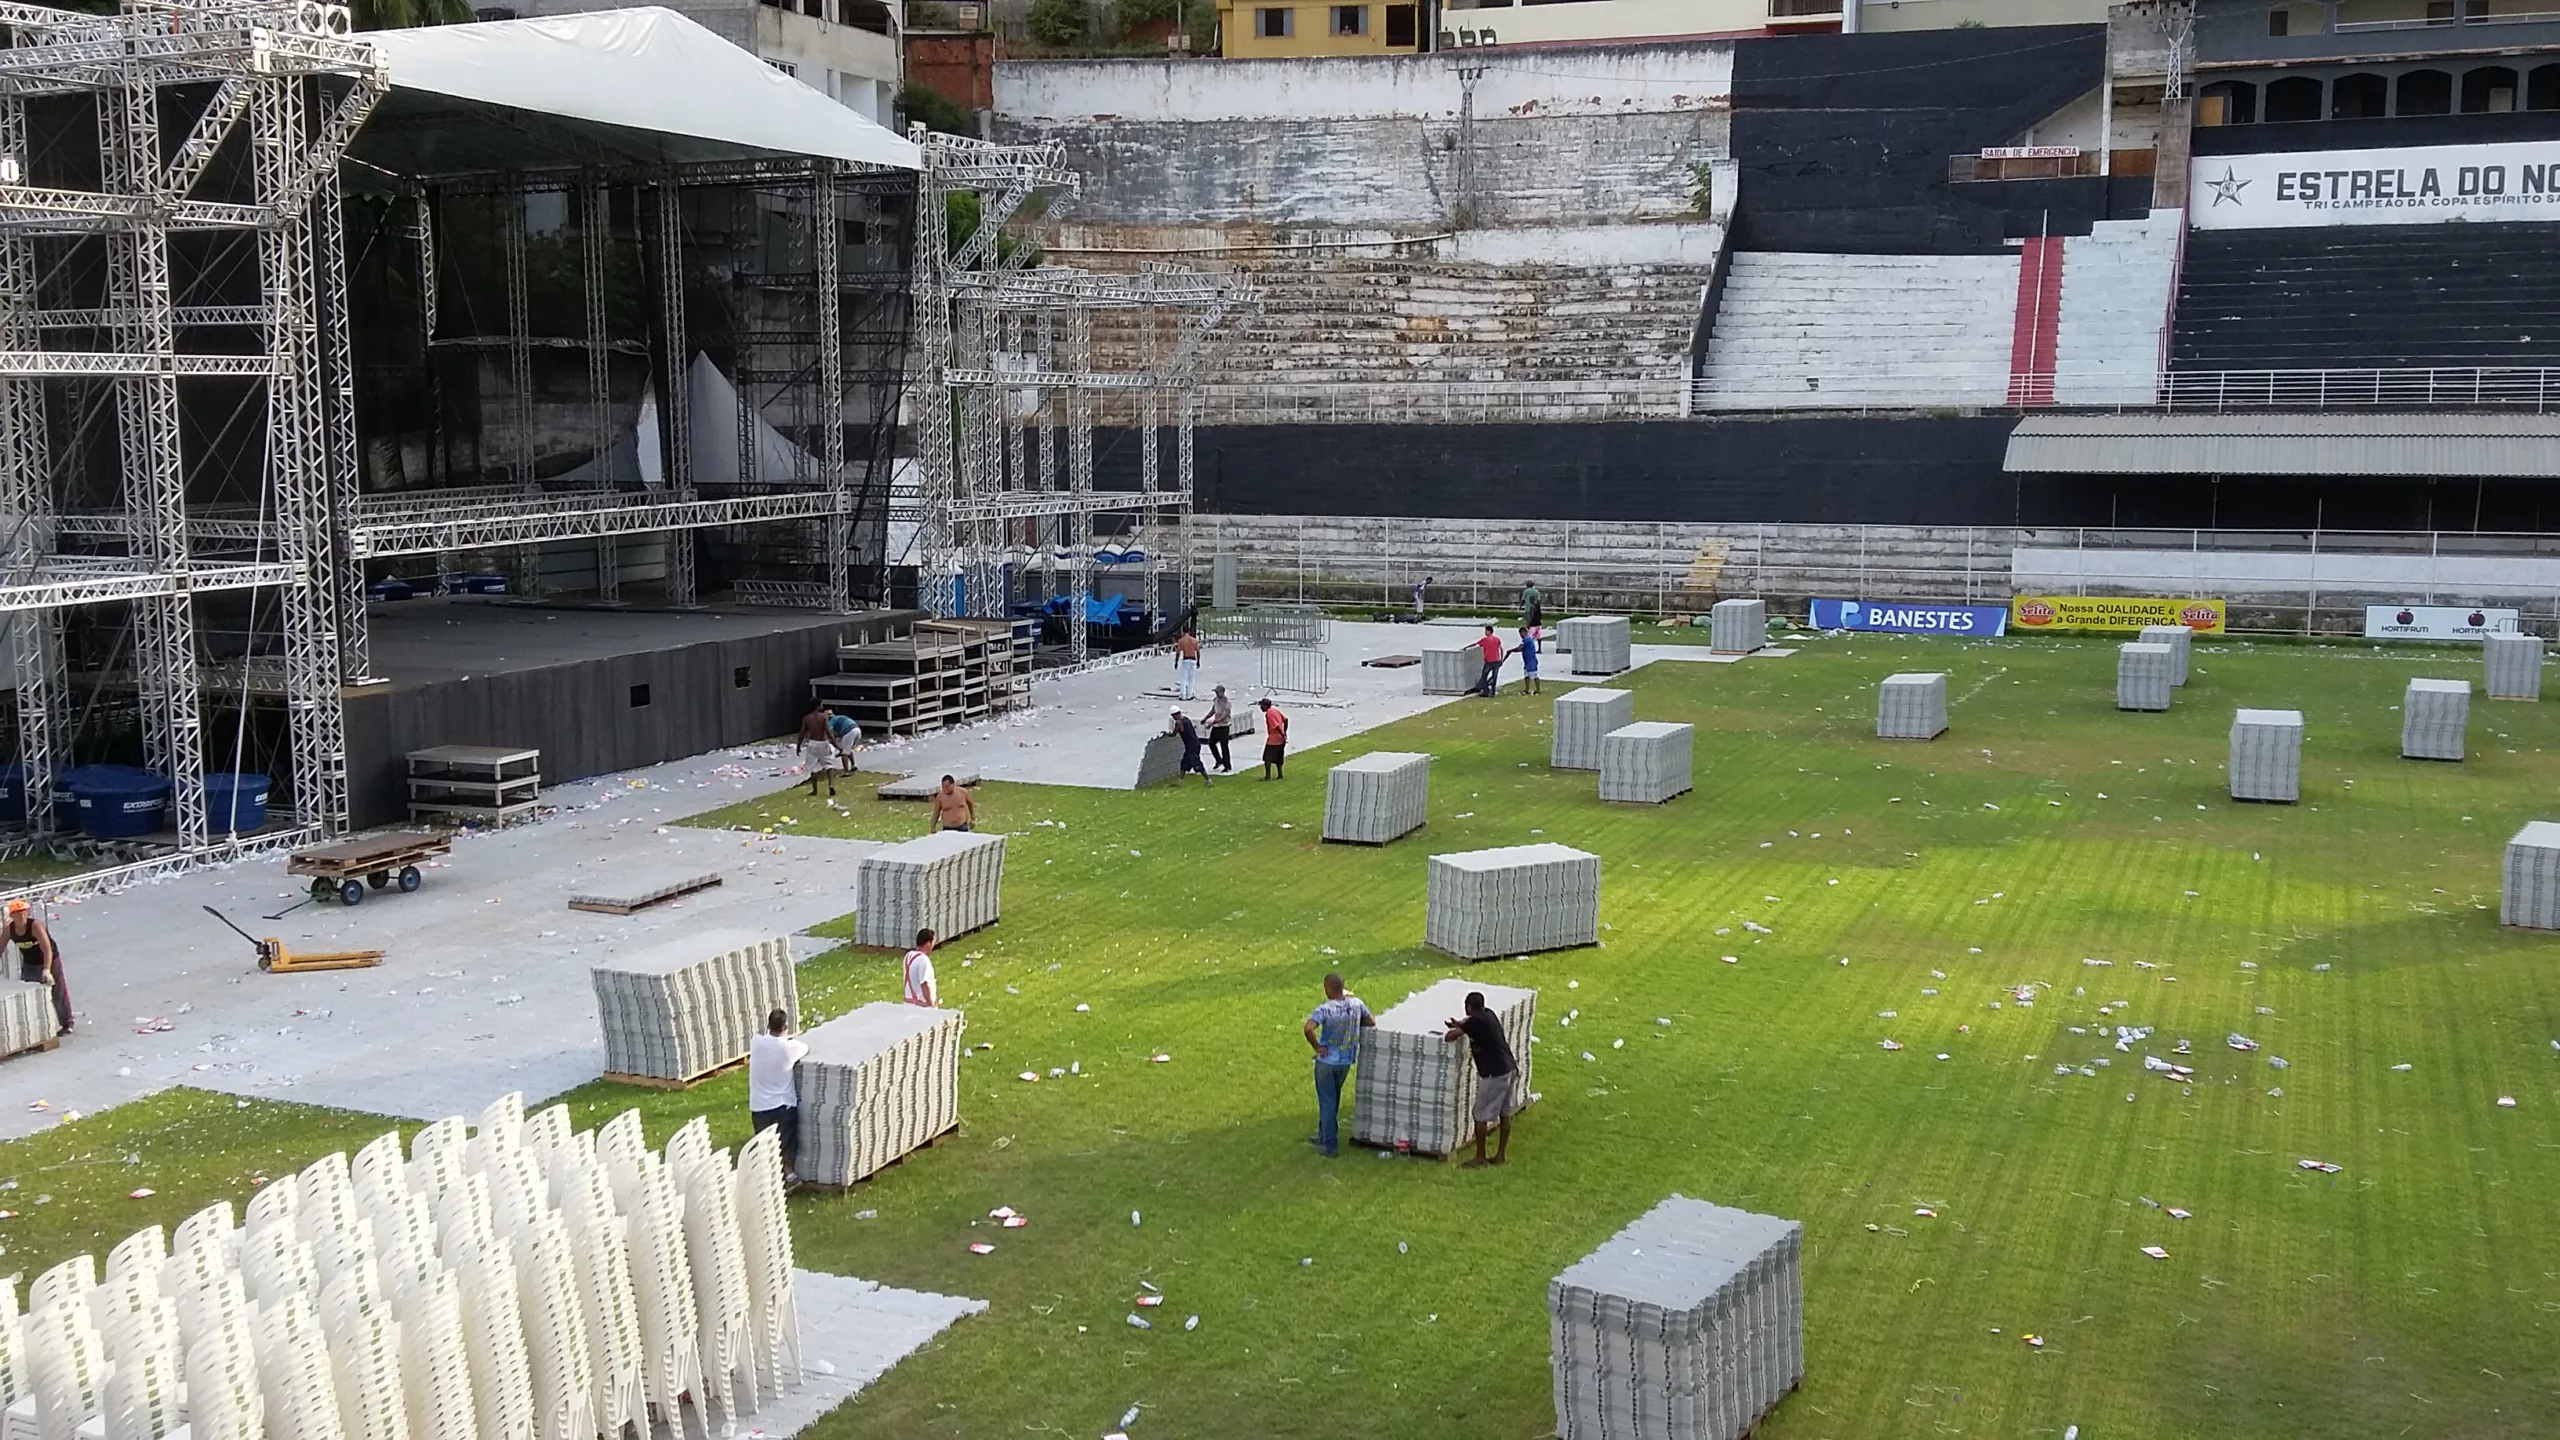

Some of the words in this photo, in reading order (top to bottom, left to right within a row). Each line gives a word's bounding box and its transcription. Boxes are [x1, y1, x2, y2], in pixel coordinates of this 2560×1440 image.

[2013, 148, 2023, 157] DE
[2277, 168, 2441, 201] ESTRELA
[2458, 165, 2505, 196] DO
[2408, 199, 2426, 207] DA
[2431, 197, 2469, 206] COPA
[2474, 194, 2541, 205] ESPÍRITO
[2019, 603, 2056, 616] Selita
[2060, 603, 2094, 613] Nossa
[2096, 604, 2165, 615] QUALIDADE
[2181, 608, 2219, 620] Selita
[1869, 608, 1974, 631] BANESTES
[2057, 616, 2063, 624] a
[2066, 615, 2106, 625] Grande
[2381, 625, 2429, 633] HORTIFRUTI
